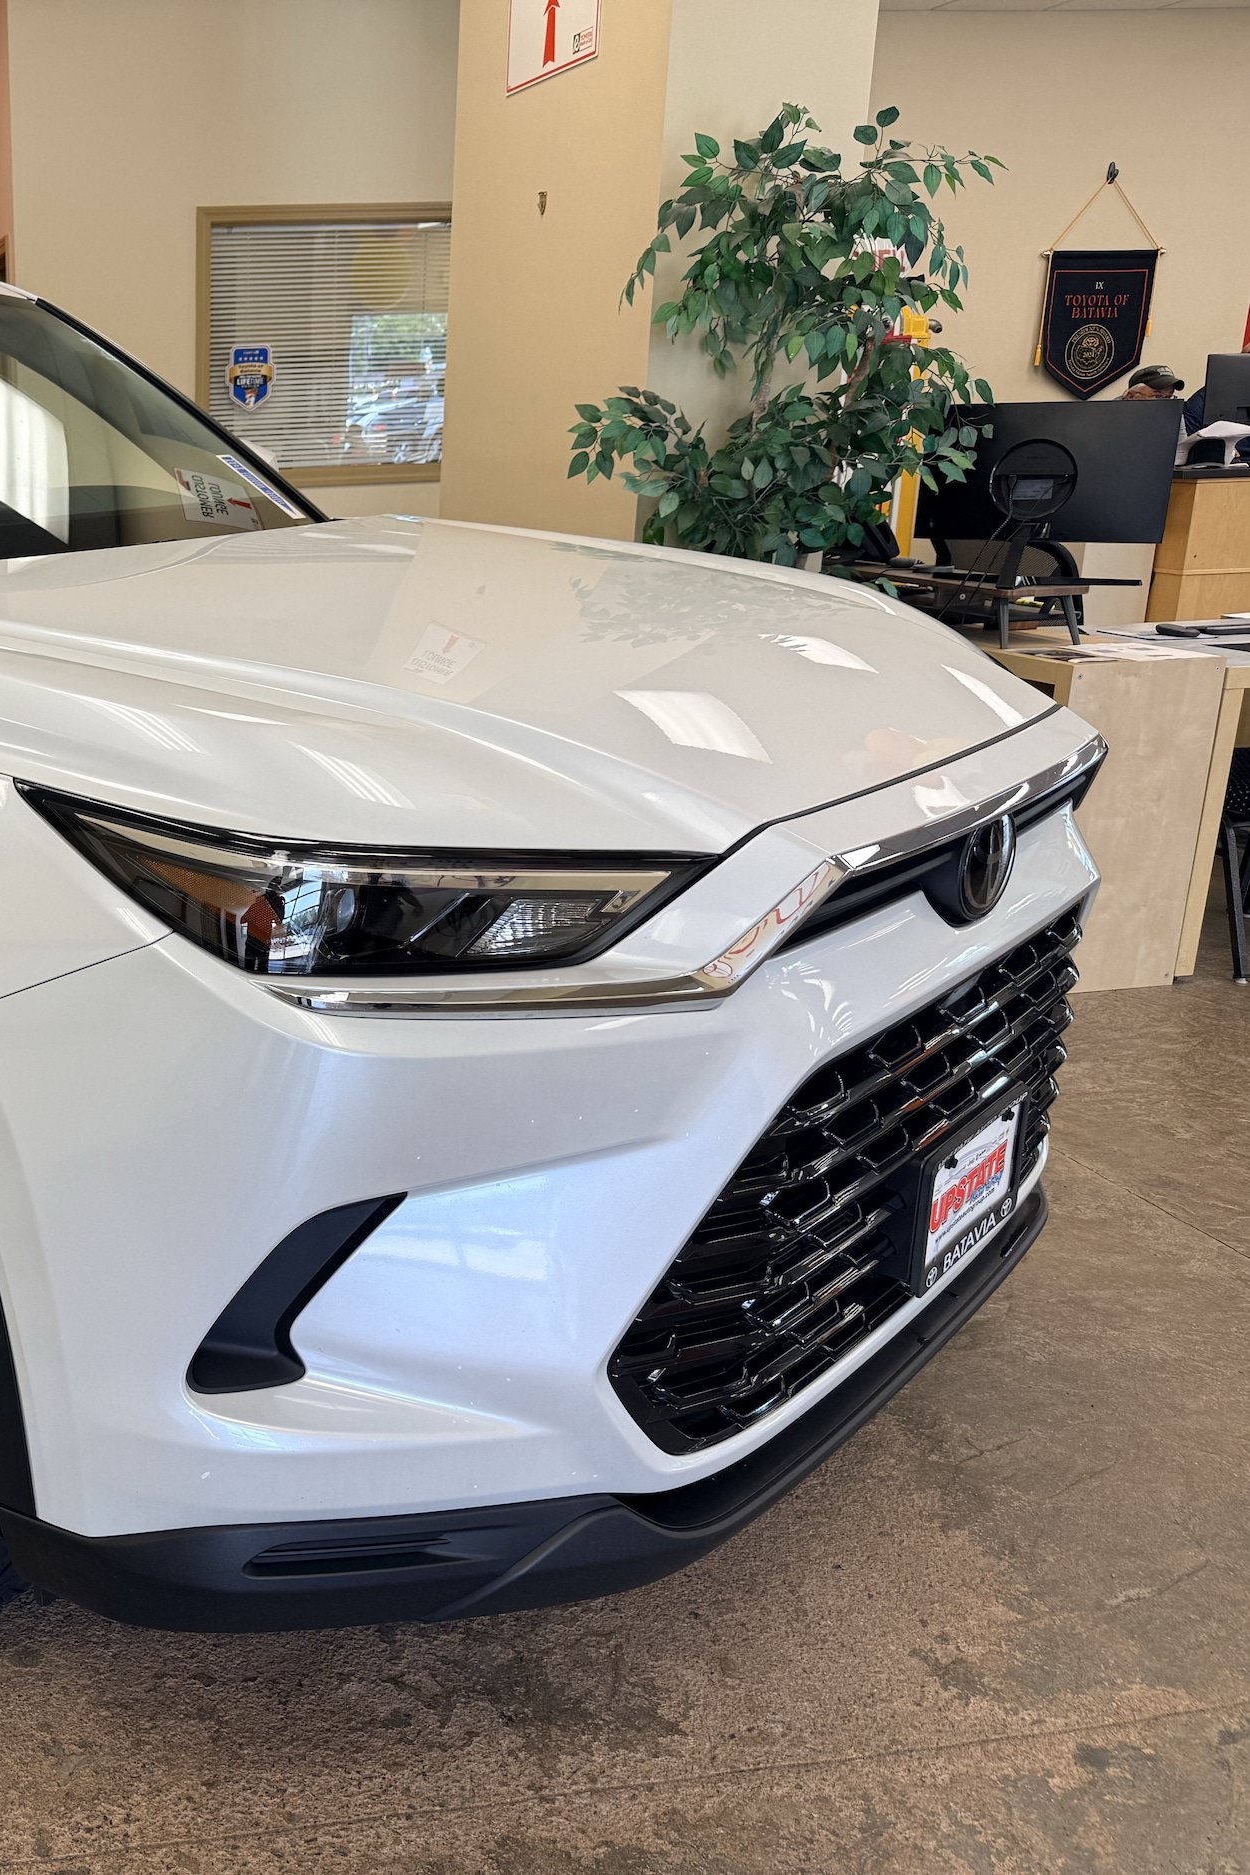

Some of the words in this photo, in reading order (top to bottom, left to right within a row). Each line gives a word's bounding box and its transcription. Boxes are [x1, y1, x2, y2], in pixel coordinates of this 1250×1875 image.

[1095, 281, 1104, 290] IX
[1064, 294, 1109, 306] TOYOTA
[1114, 294, 1130, 305] OF
[1071, 307, 1119, 319] BATAVIA
[928, 1139, 1010, 1234] UPSTATE
[942, 1211, 996, 1274] BATAVIA
